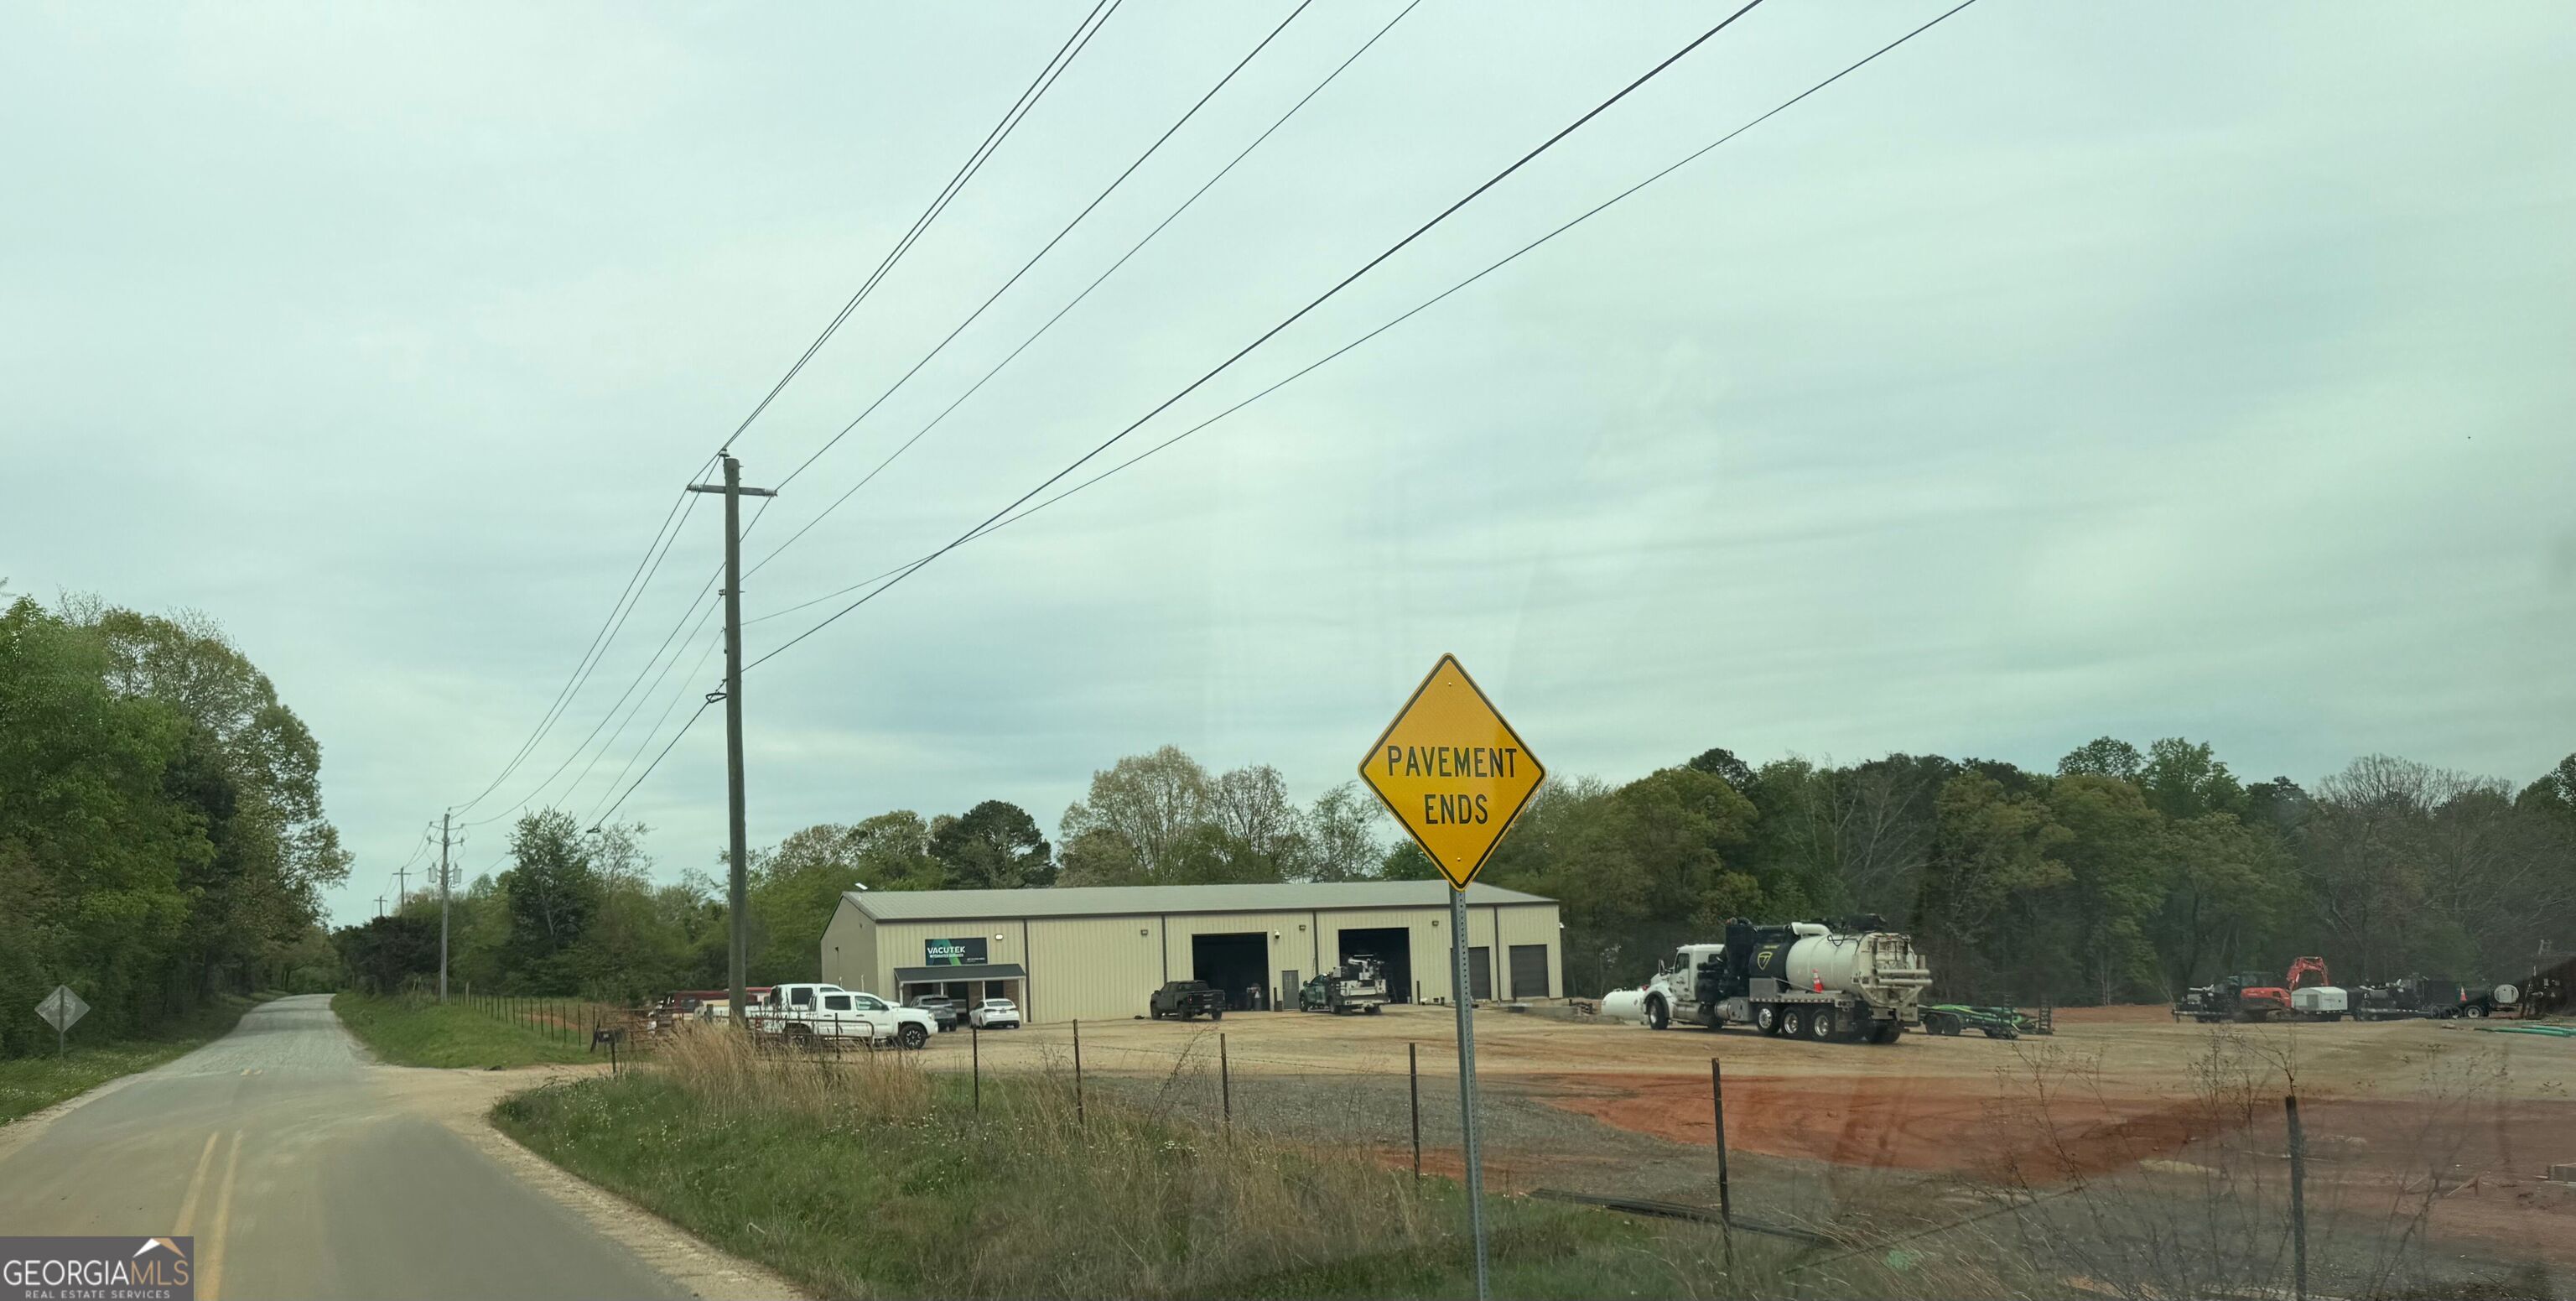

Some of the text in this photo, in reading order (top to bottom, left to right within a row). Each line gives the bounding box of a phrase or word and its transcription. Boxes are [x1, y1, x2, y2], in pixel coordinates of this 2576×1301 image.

[1387, 745, 1517, 778] PAVEMENT
[1424, 794, 1488, 825] ENDS
[927, 945, 966, 955] VACUTEK
